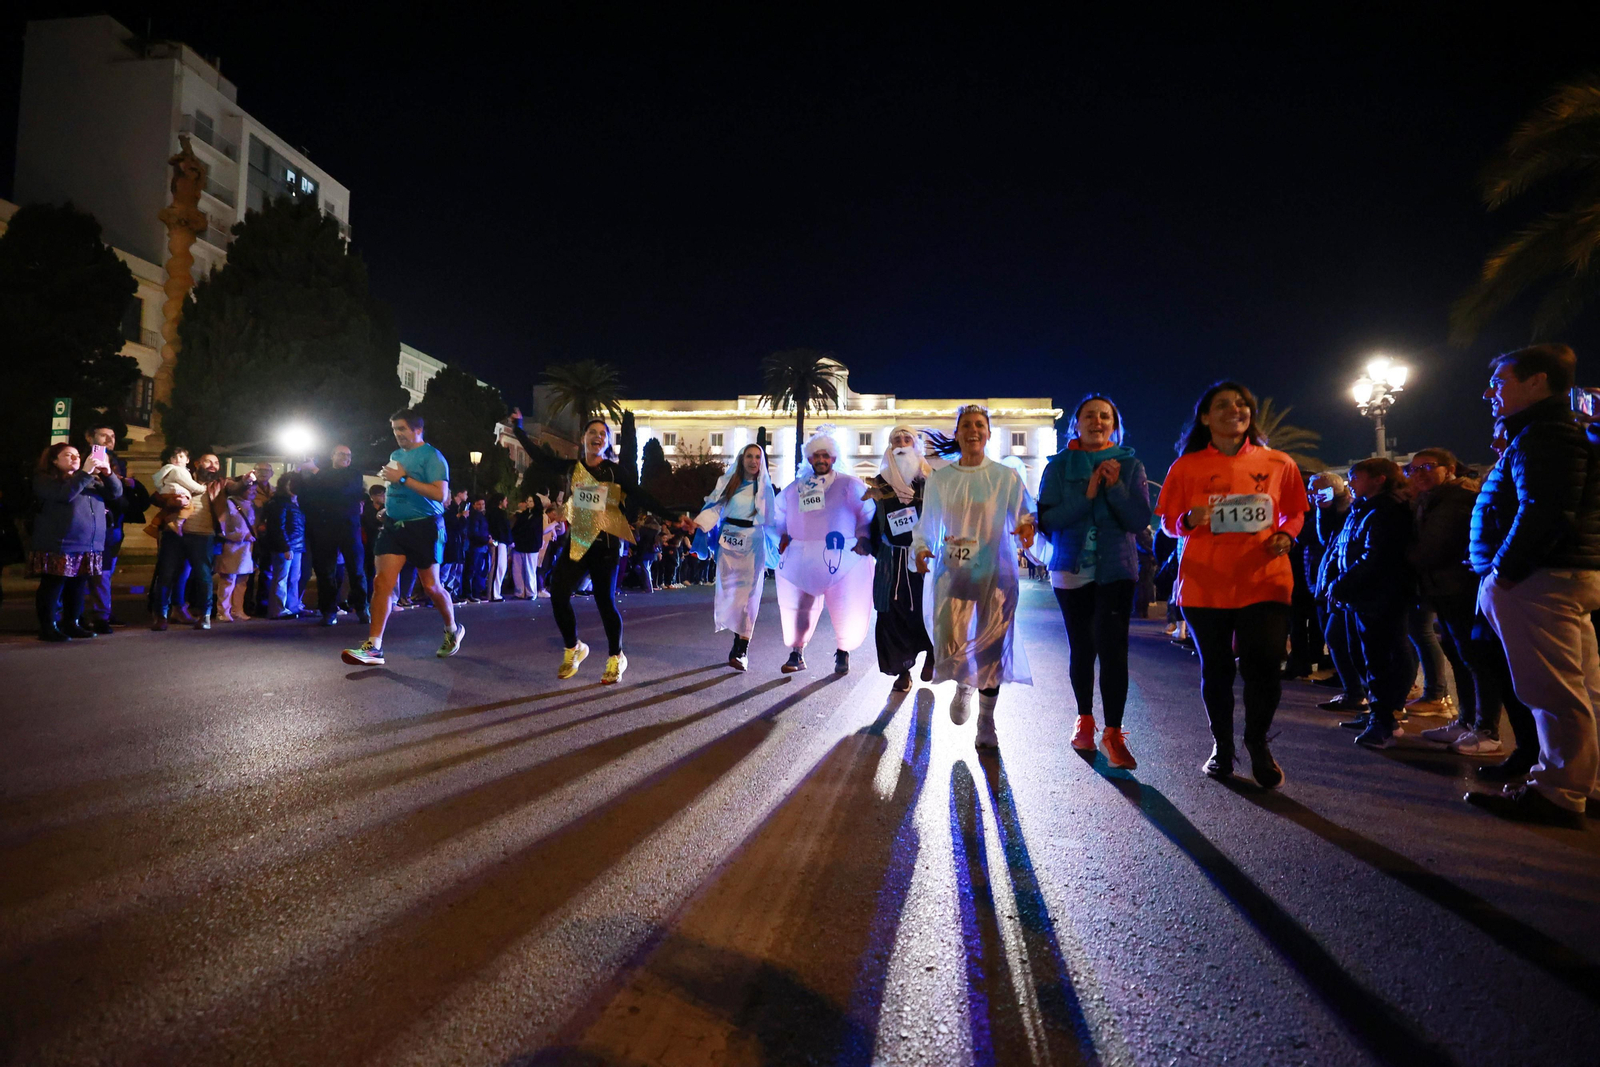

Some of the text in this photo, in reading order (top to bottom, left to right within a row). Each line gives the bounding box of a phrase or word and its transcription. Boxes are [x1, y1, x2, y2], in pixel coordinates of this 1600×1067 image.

[580, 492, 600, 504] 998
[803, 496, 821, 506] 1568
[1215, 507, 1267, 523] 1138
[894, 516, 914, 528] 1521
[723, 536, 744, 547] 1434
[949, 546, 971, 561] 742
